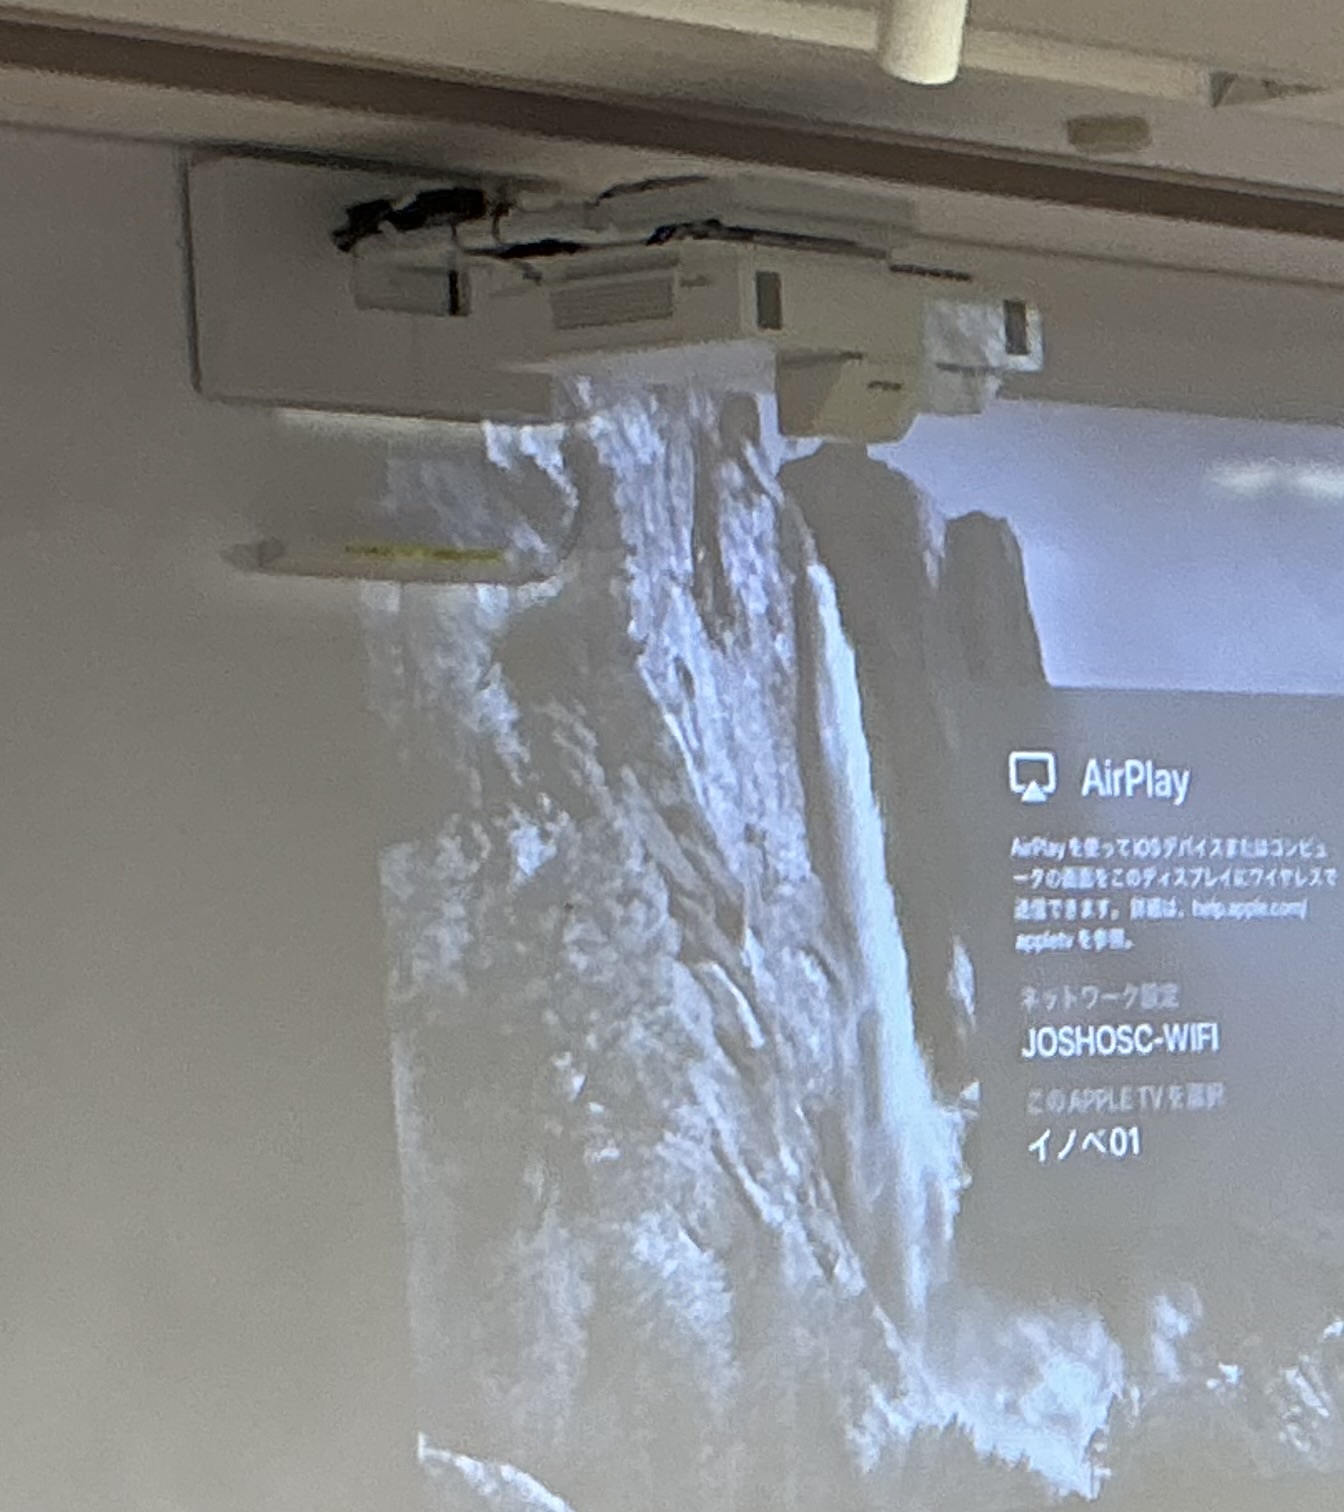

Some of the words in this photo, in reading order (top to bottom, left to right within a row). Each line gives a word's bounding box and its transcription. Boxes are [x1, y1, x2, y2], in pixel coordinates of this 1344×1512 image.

[1081, 758, 1191, 805] AirPlay
[1021, 1022, 1220, 1059] JOSHOSC-WIFI
[1028, 1126, 1141, 1163] イノベ01
